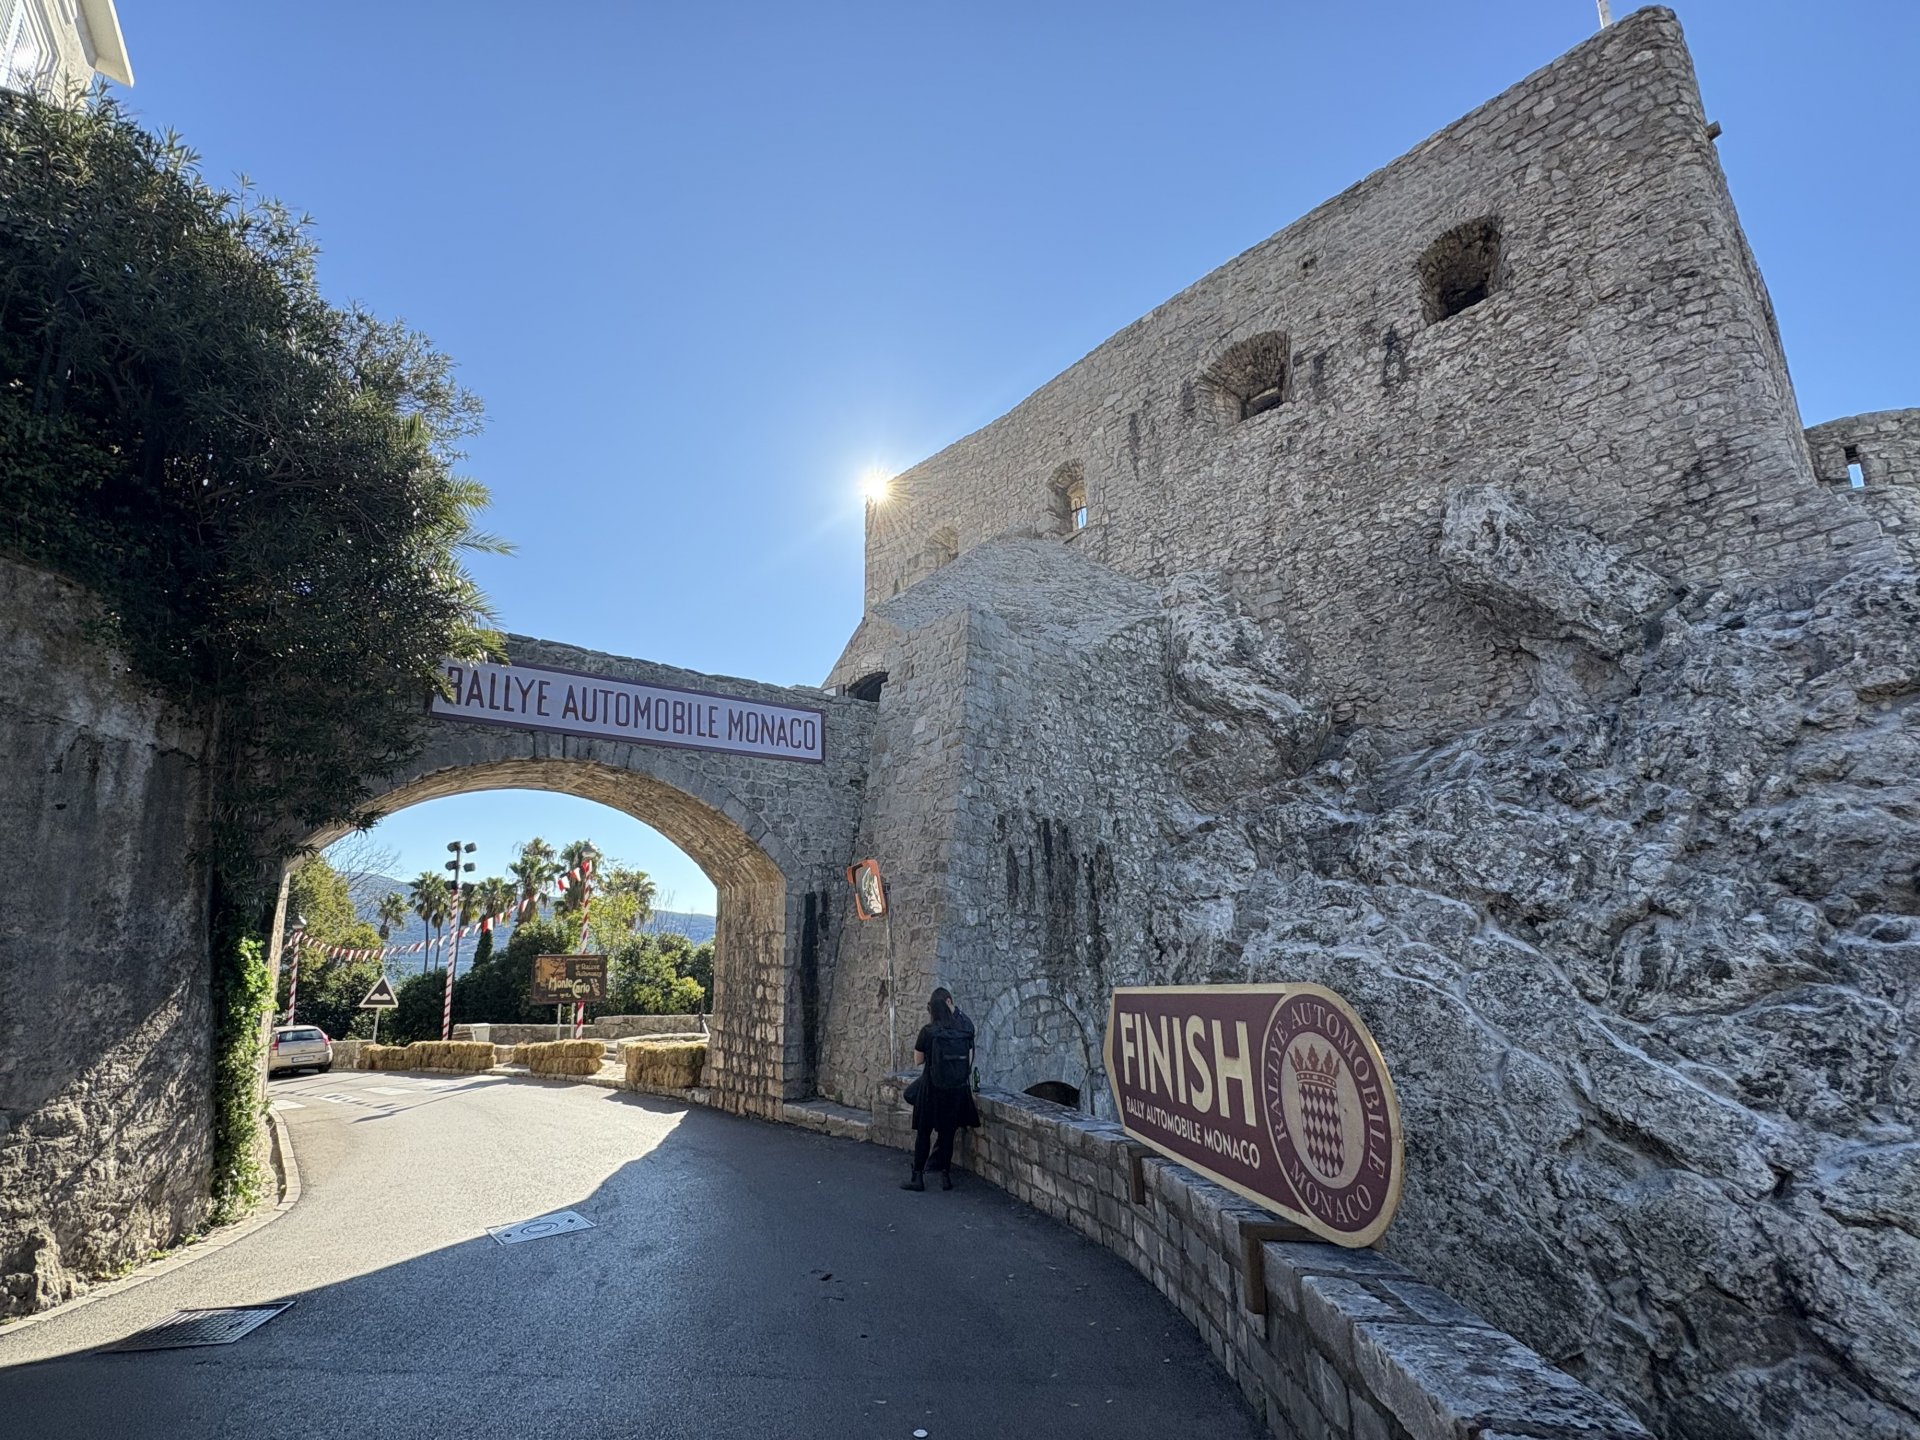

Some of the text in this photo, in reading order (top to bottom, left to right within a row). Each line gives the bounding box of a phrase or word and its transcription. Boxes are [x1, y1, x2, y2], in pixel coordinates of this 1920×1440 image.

[448, 666, 816, 751] RALLYE AUTOMOBILE MONACO
[1119, 1011, 1257, 1128] FINISH
[1266, 1002, 1386, 1179] RALLYE AUTOMOBILE
[1125, 1095, 1260, 1170] RALLY AUTOMOBILE MONACO
[1290, 1160, 1372, 1224] MONACO
